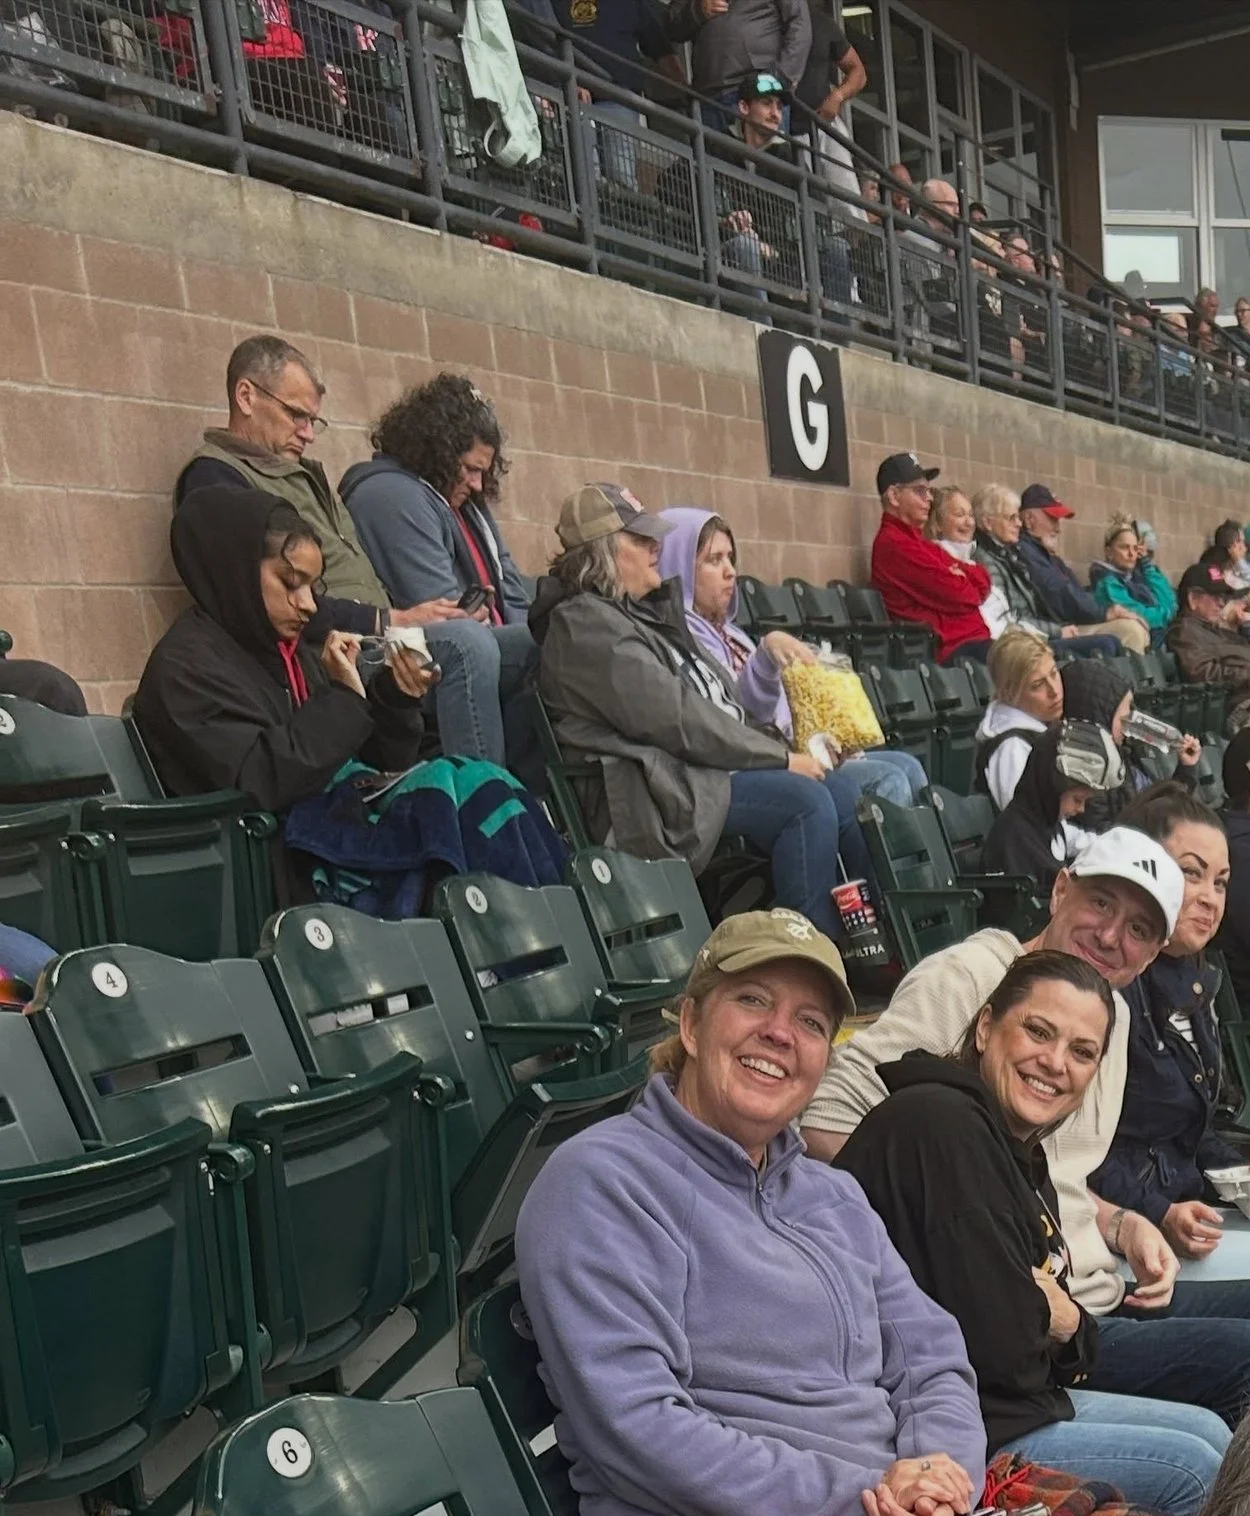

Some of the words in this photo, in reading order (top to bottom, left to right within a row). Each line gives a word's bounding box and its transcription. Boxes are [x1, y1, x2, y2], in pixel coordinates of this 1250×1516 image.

[786, 343, 830, 472] G
[313, 926, 325, 942] 3
[104, 971, 119, 989] 4
[281, 1439, 297, 1465] 6
